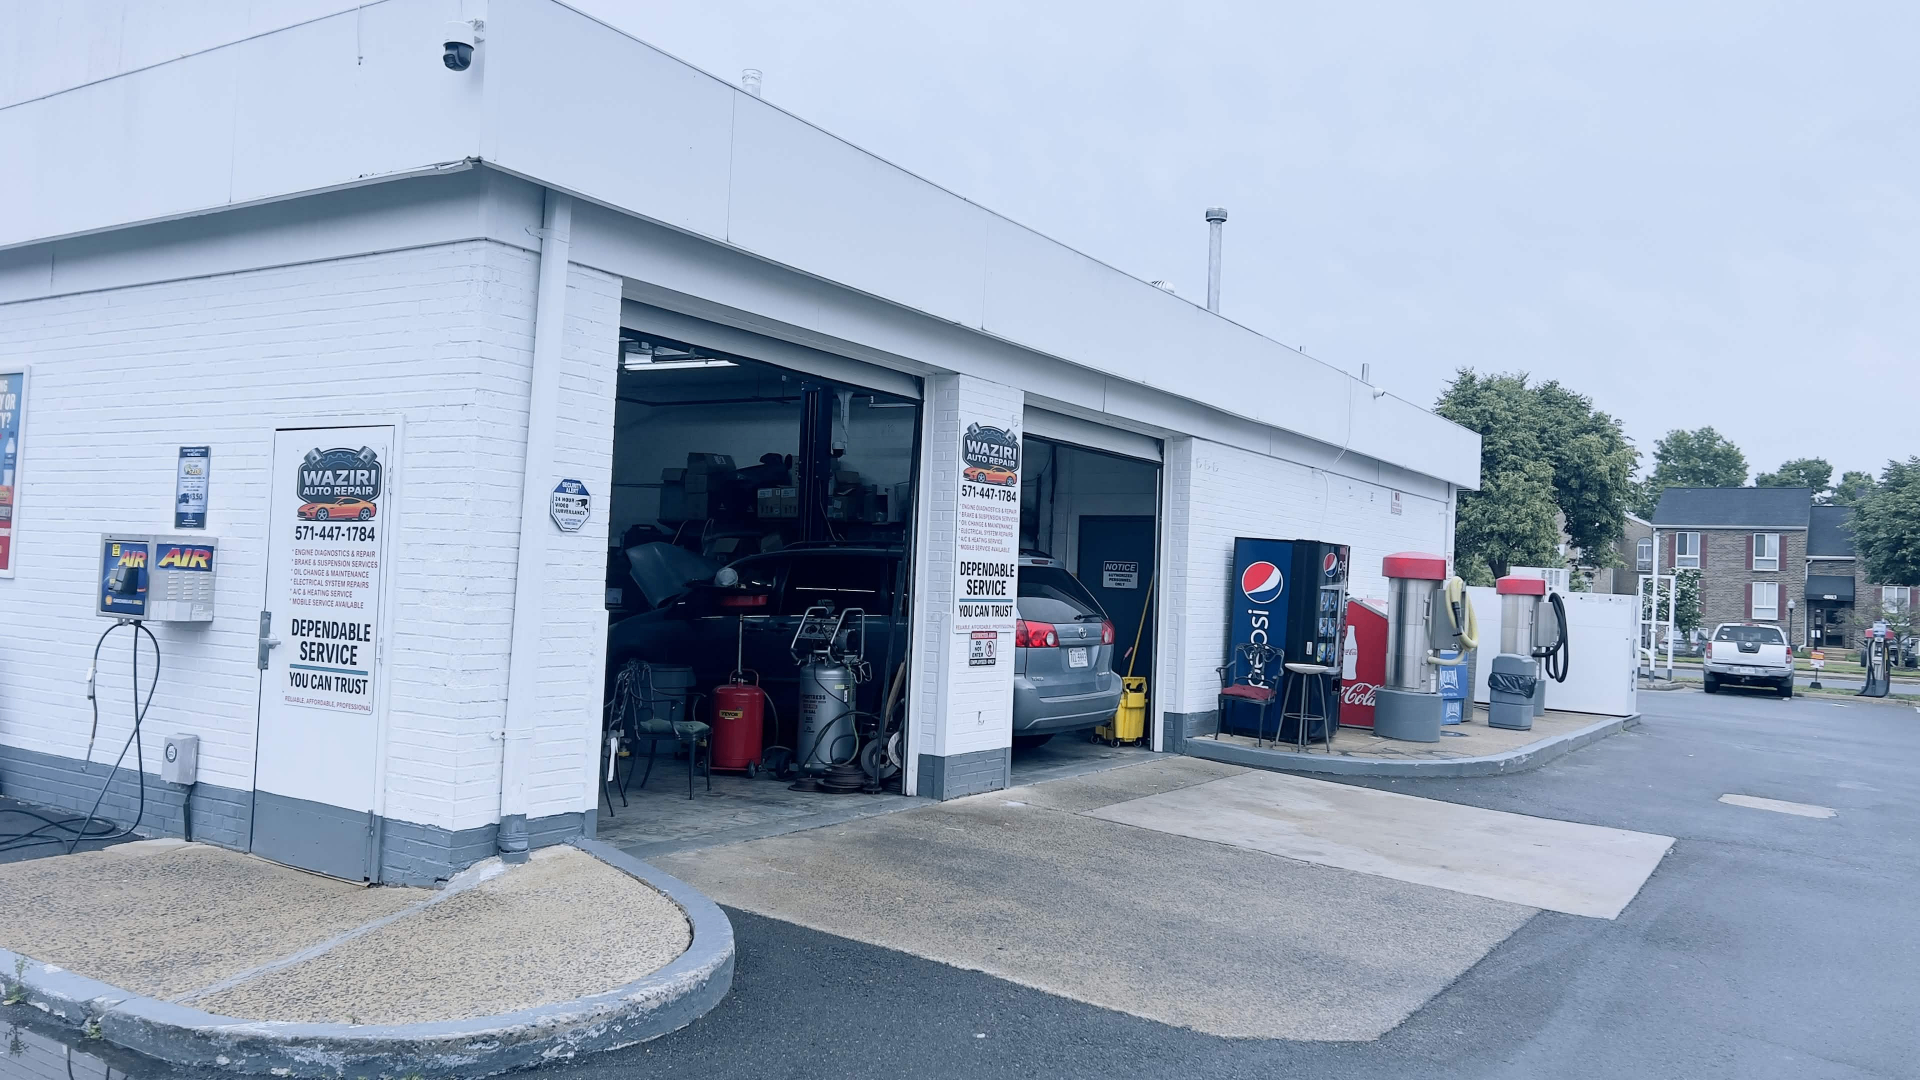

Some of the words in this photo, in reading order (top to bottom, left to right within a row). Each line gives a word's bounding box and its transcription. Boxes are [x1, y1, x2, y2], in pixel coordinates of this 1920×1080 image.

[5, 394, 16, 410] OR
[0, 412, 11, 428] Y?
[967, 440, 1016, 460] WAZIRI
[967, 454, 987, 463] AUTO
[989, 457, 1015, 467] REPAIR
[303, 470, 376, 485] WAZIRI
[303, 486, 331, 495] AUTO
[334, 486, 373, 495] REPAIR
[962, 485, 1016, 502] 571-447-1784
[976, 505, 1000, 513] DIAGNOSTICS
[295, 526, 375, 542] 571-447-1784
[988, 522, 1013, 530] MAINTENANCE
[118, 550, 147, 568] AIR
[158, 547, 211, 569] AIR
[331, 570, 369, 578] MAINTENANCE
[960, 561, 1014, 577] DEPENDABLE
[294, 578, 323, 586] ELECTRICAL
[966, 579, 1006, 595] SERVICE
[330, 590, 352, 598] SERVICE
[312, 599, 334, 607] SERVICE
[335, 600, 364, 609] AVAILABLE
[959, 605, 973, 617] YOU
[975, 605, 989, 617] CAN
[991, 605, 1013, 617] TRUST
[292, 619, 371, 642] DEPENDABLE
[300, 641, 357, 665] SERVICE
[290, 672, 308, 688] YOU
[311, 674, 331, 691] CAN
[335, 677, 368, 695] TRUST
[285, 696, 305, 704] RELIABLE,
[306, 698, 335, 708] AFFORDABLE,
[337, 702, 371, 711] PROFESSIONAL
